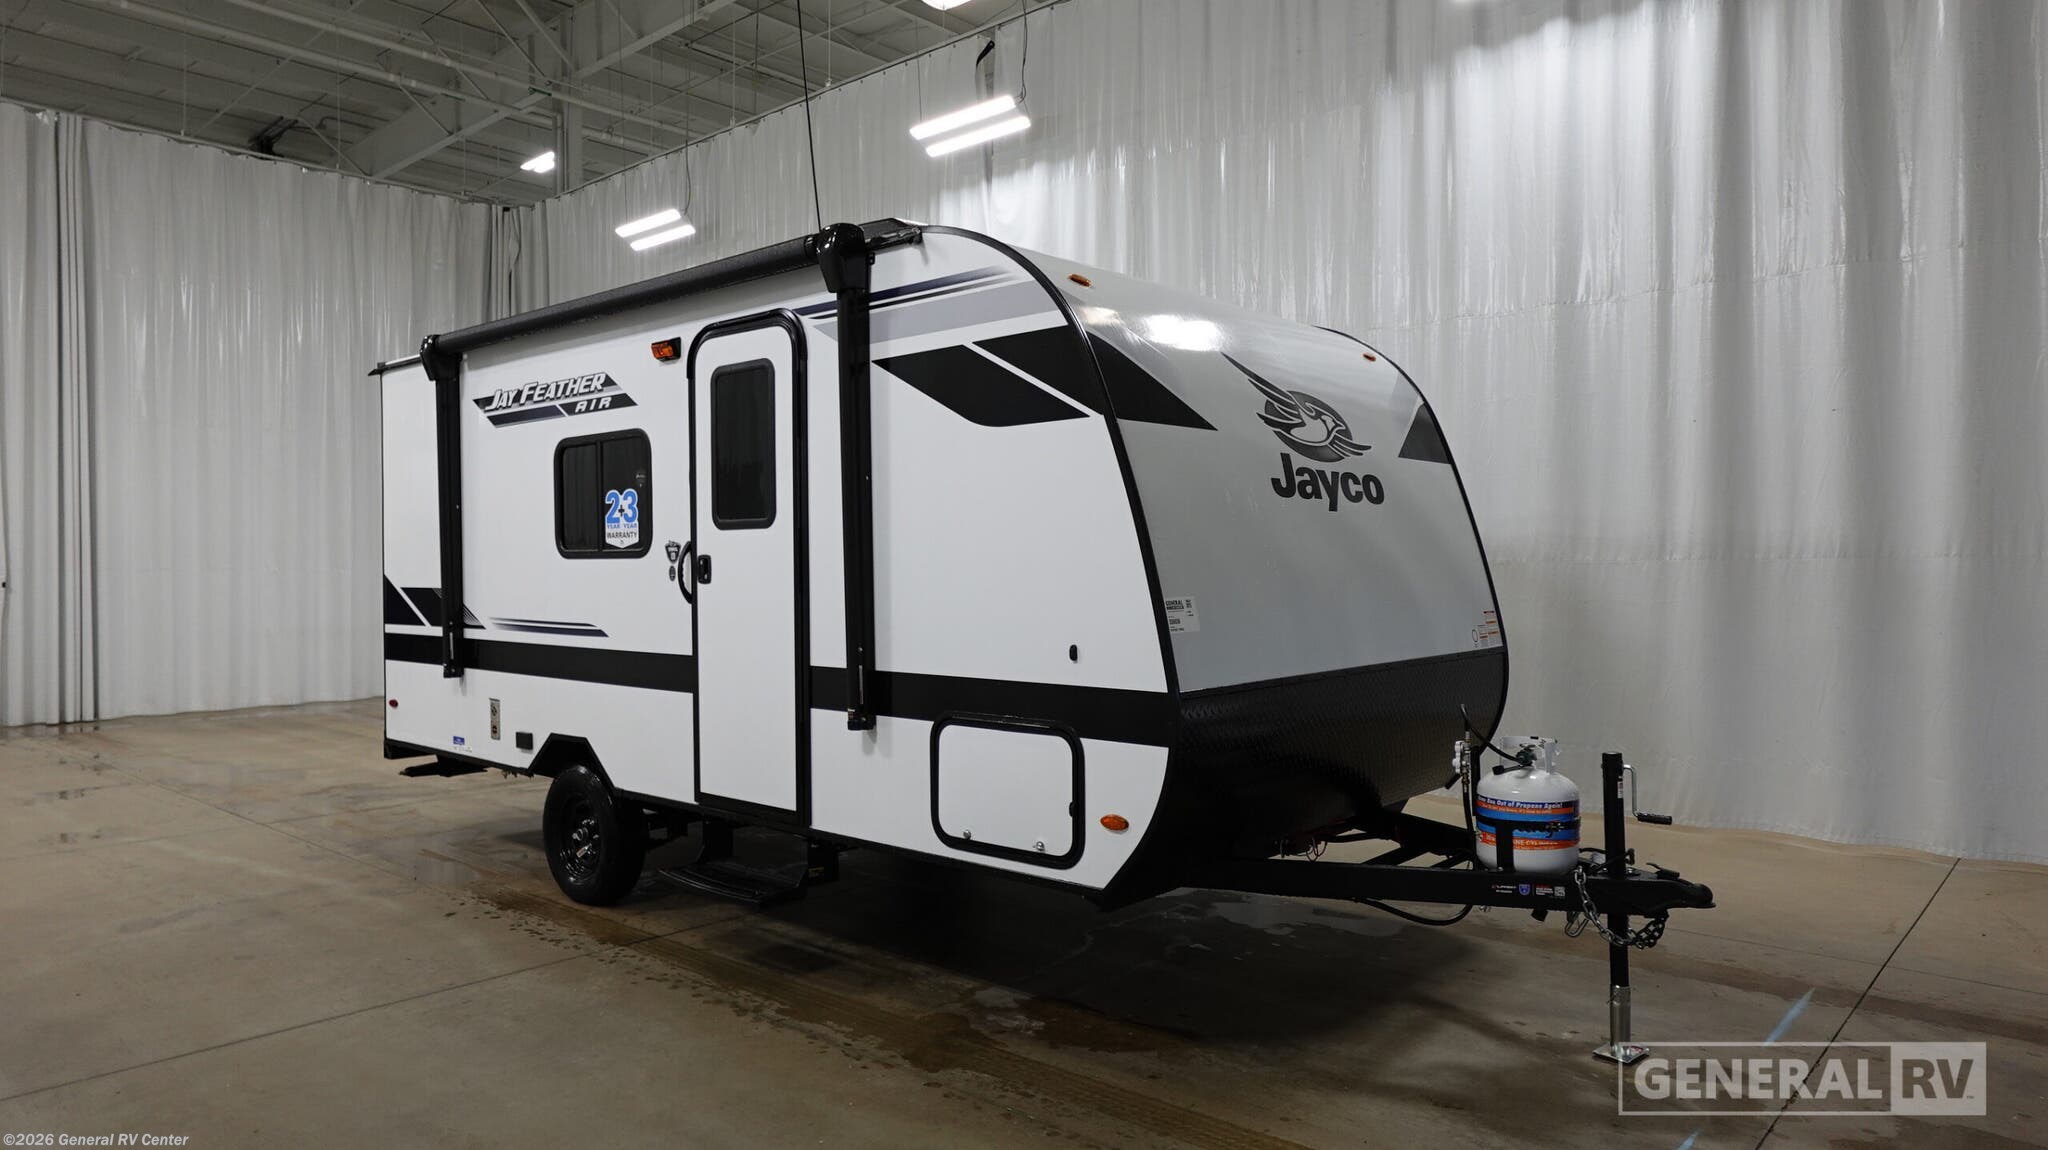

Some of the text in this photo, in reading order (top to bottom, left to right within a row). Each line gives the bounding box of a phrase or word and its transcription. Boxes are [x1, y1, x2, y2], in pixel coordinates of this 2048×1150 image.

[484, 372, 607, 412] JAY FEATHER
[574, 397, 612, 413] AIR
[1270, 452, 1385, 512] Jayco
[606, 531, 637, 539] WARRANTY
